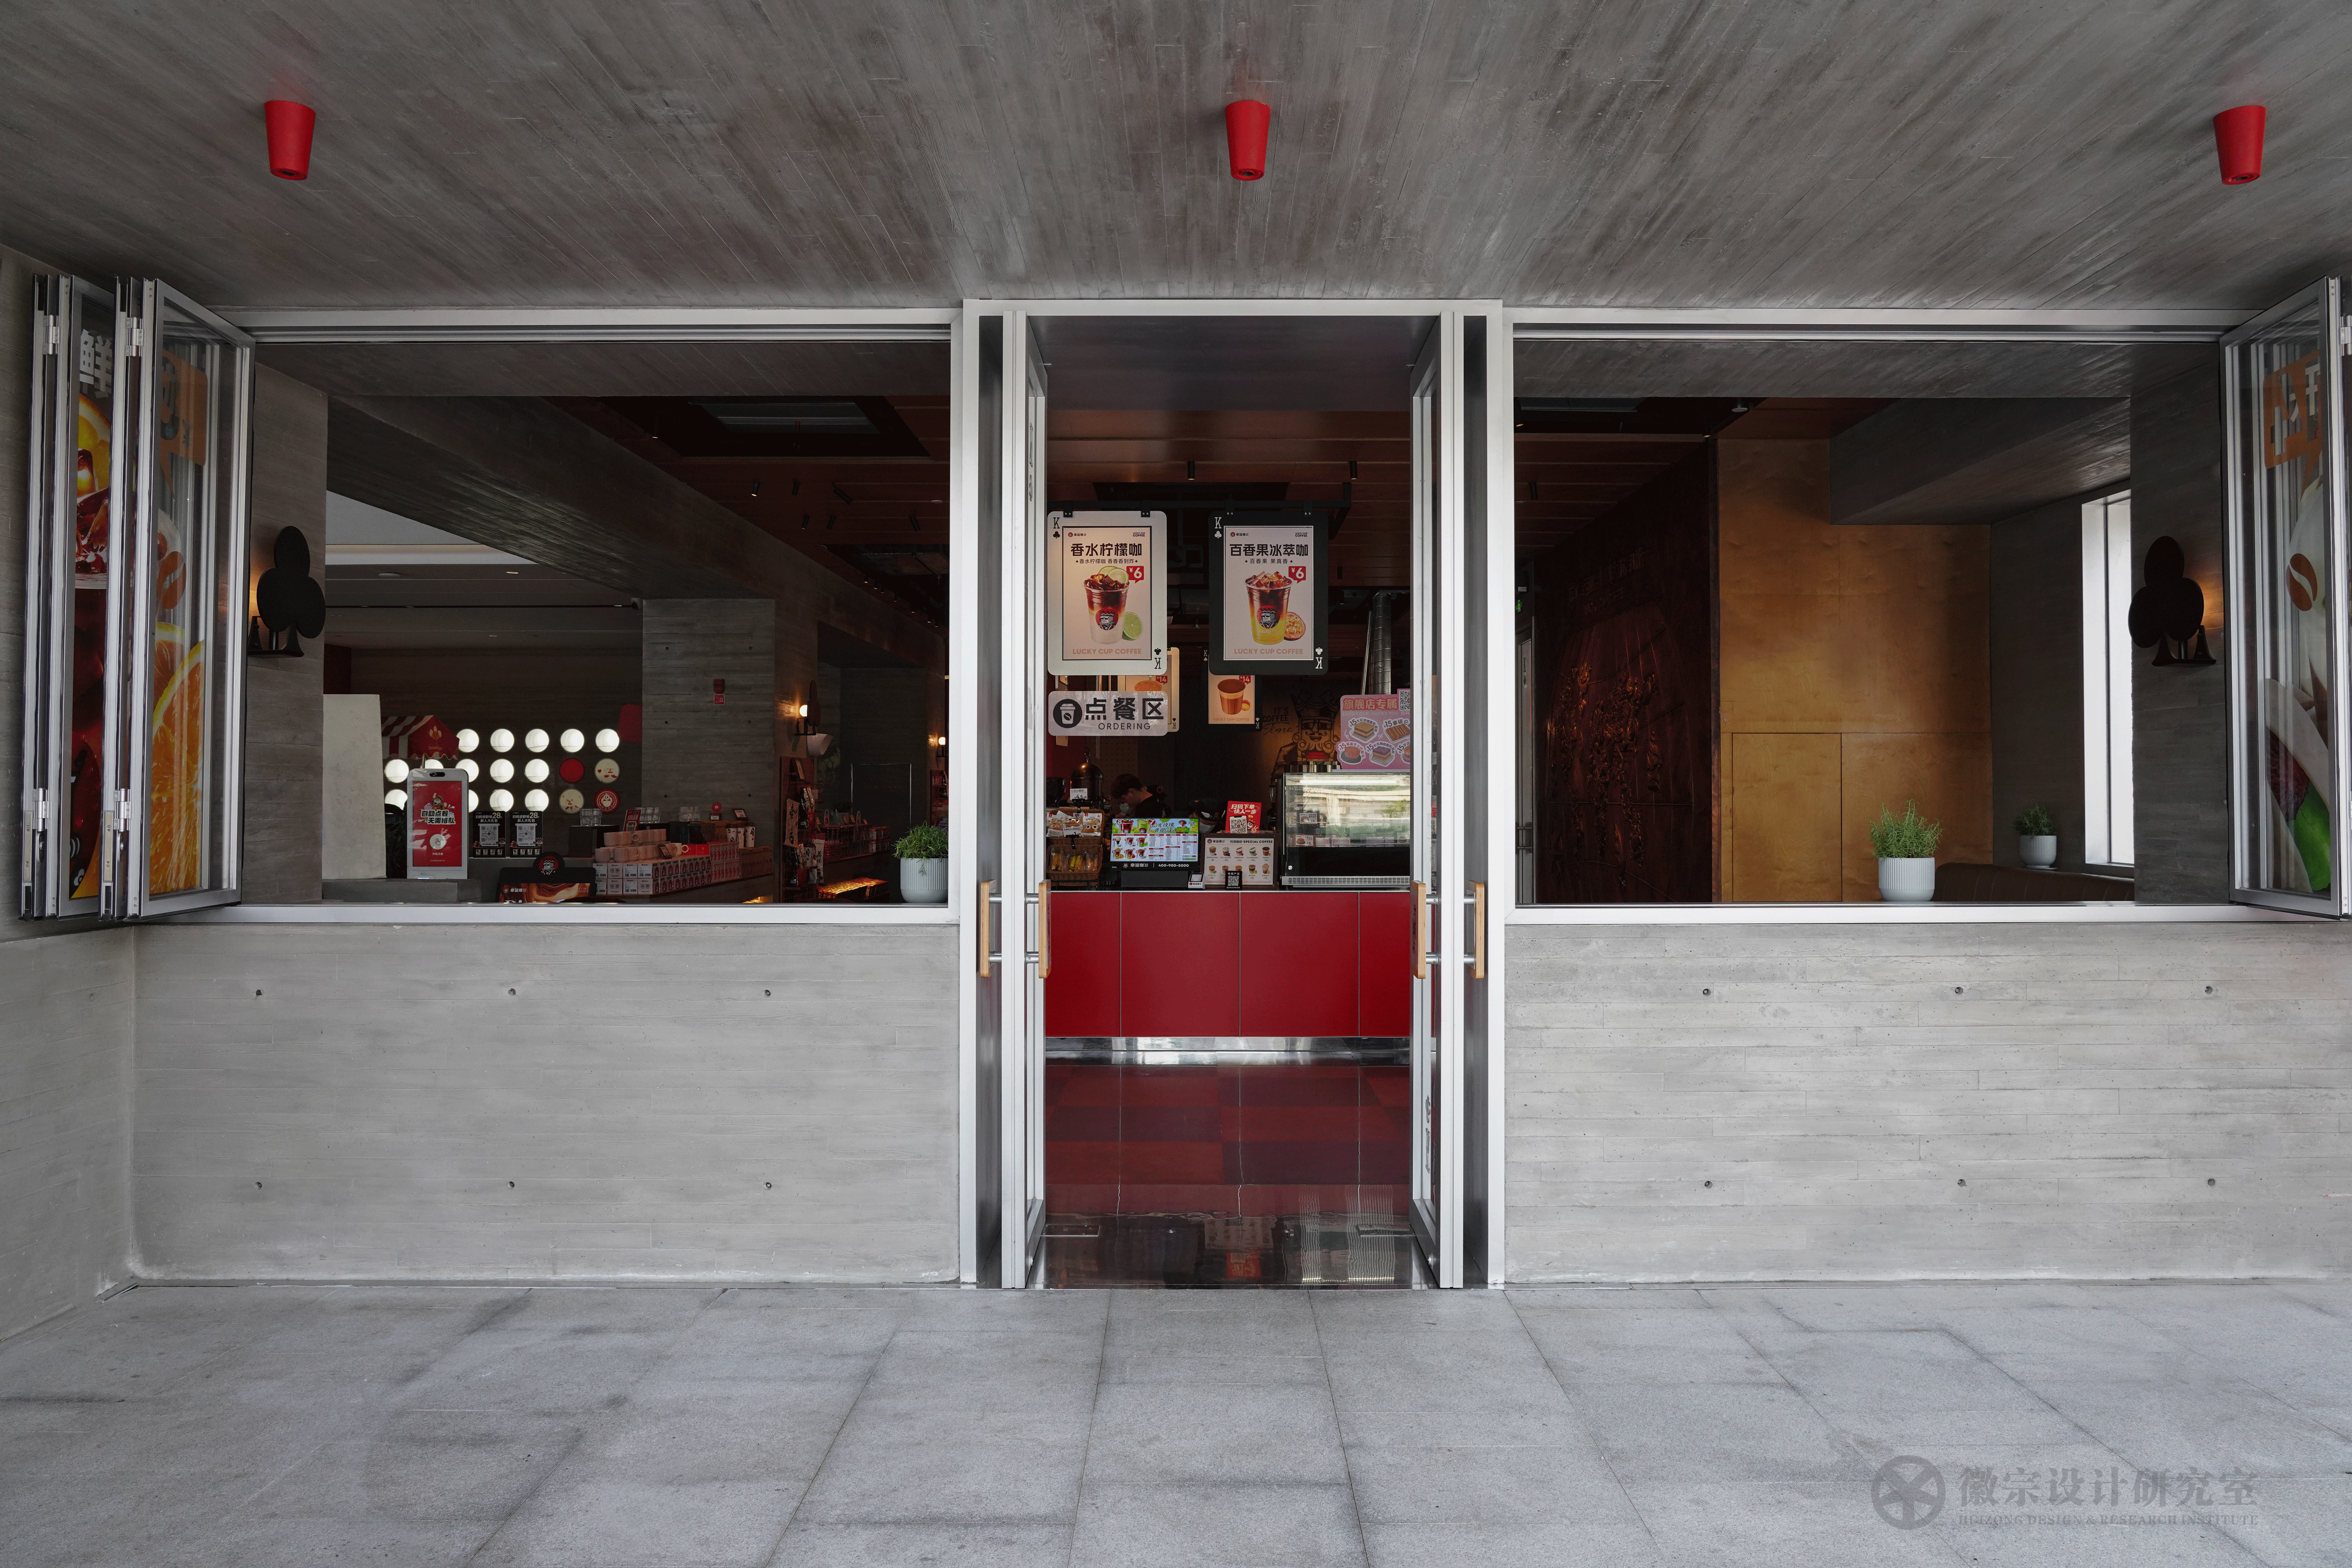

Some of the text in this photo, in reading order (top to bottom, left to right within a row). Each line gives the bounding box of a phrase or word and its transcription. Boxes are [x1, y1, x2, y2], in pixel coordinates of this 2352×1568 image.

[1053, 517, 1060, 529] K
[1215, 517, 1222, 529] K
[1071, 543, 1142, 556] 香水柠檬咖
[1230, 544, 1308, 556] 百香果冰萃咖
[1129, 567, 1142, 579] ¥6
[1291, 567, 1304, 579] ¥6
[1154, 658, 1161, 669] K
[1315, 657, 1323, 669] K
[1085, 698, 1164, 720] 点餐区
[1344, 698, 1398, 710] 旗舰店专属
[1384, 720, 1393, 728] ¥15
